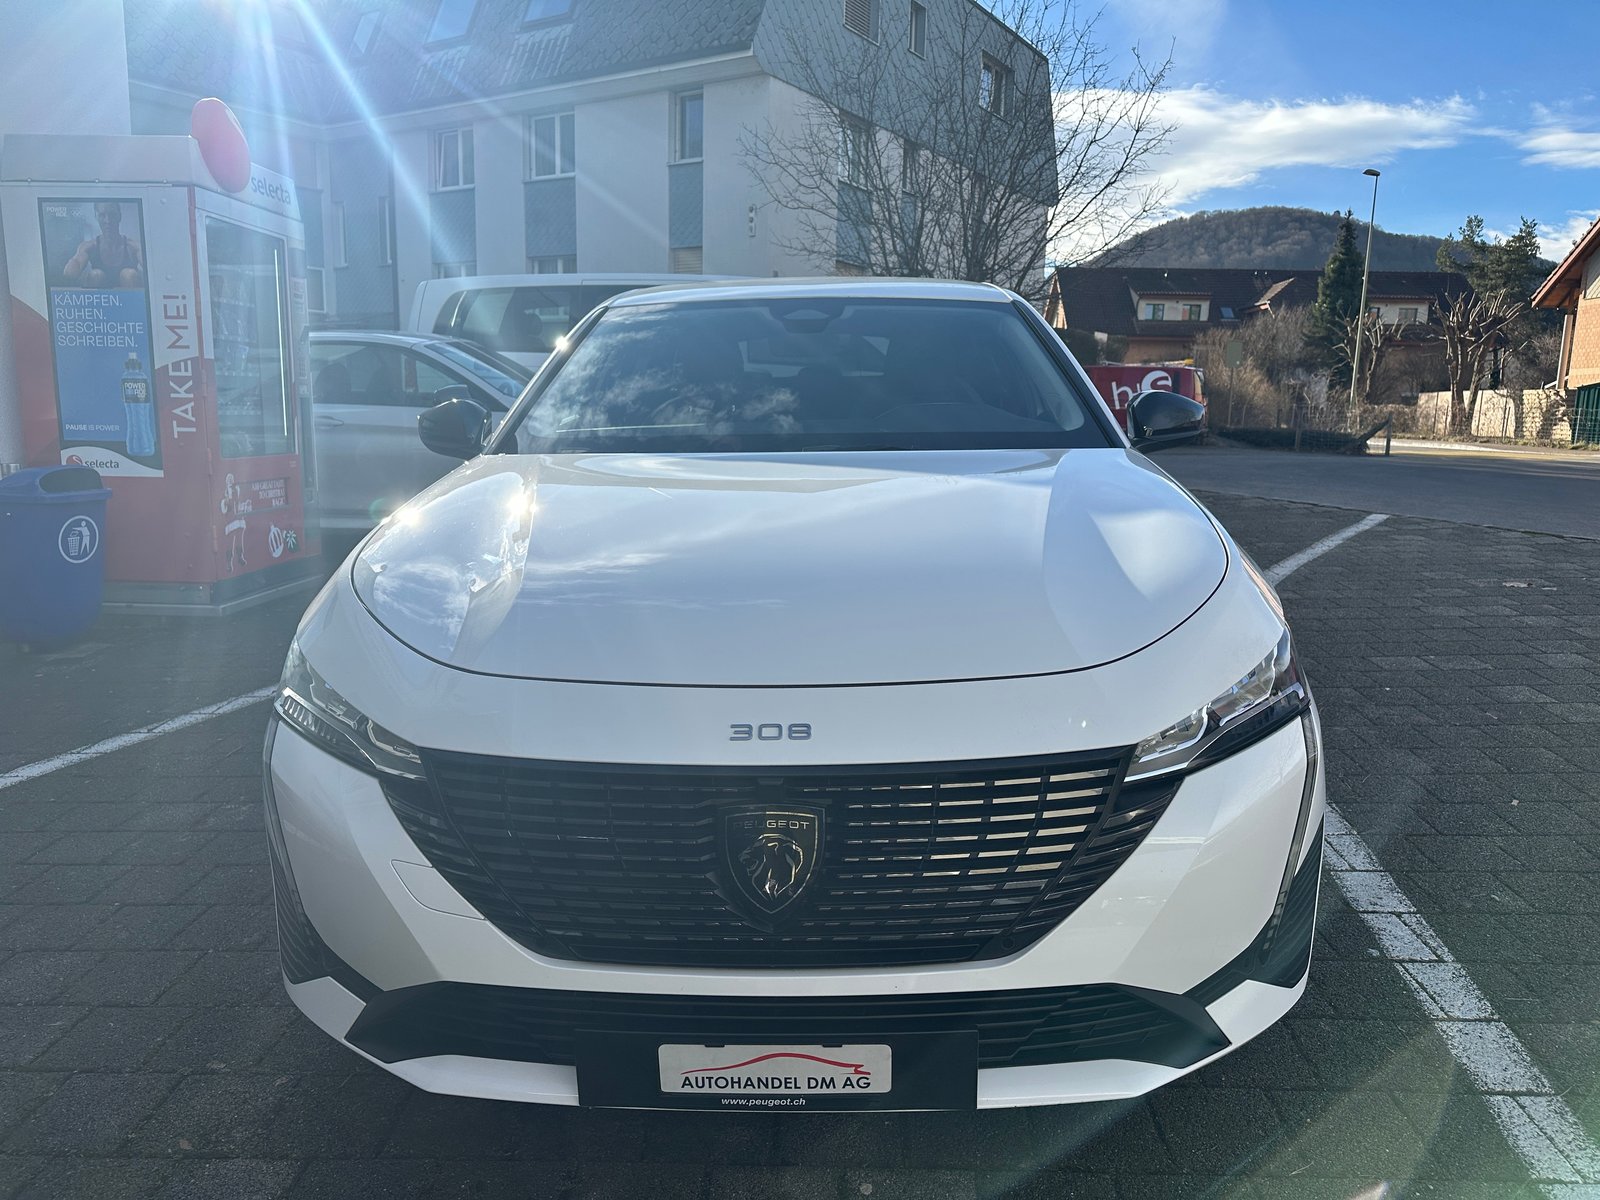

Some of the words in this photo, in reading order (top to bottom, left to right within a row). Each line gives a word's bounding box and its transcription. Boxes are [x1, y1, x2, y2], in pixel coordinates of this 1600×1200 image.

[251, 176, 291, 204] selecta
[54, 291, 122, 306] KÄMPFEN.
[56, 308, 106, 320] RUHEN.
[57, 321, 144, 334] GESCHICHTE
[162, 294, 191, 350] ME!
[58, 334, 138, 347] SCHREIBEN.
[168, 359, 197, 439] TAKE
[95, 424, 120, 432] POWER
[84, 459, 120, 469] selecta
[729, 723, 812, 741] 308
[681, 1076, 801, 1090] AUTOHANDEL
[807, 1077, 836, 1090] DM
[841, 1077, 871, 1090] AG
[721, 1098, 806, 1107] www.peugeot.ch
